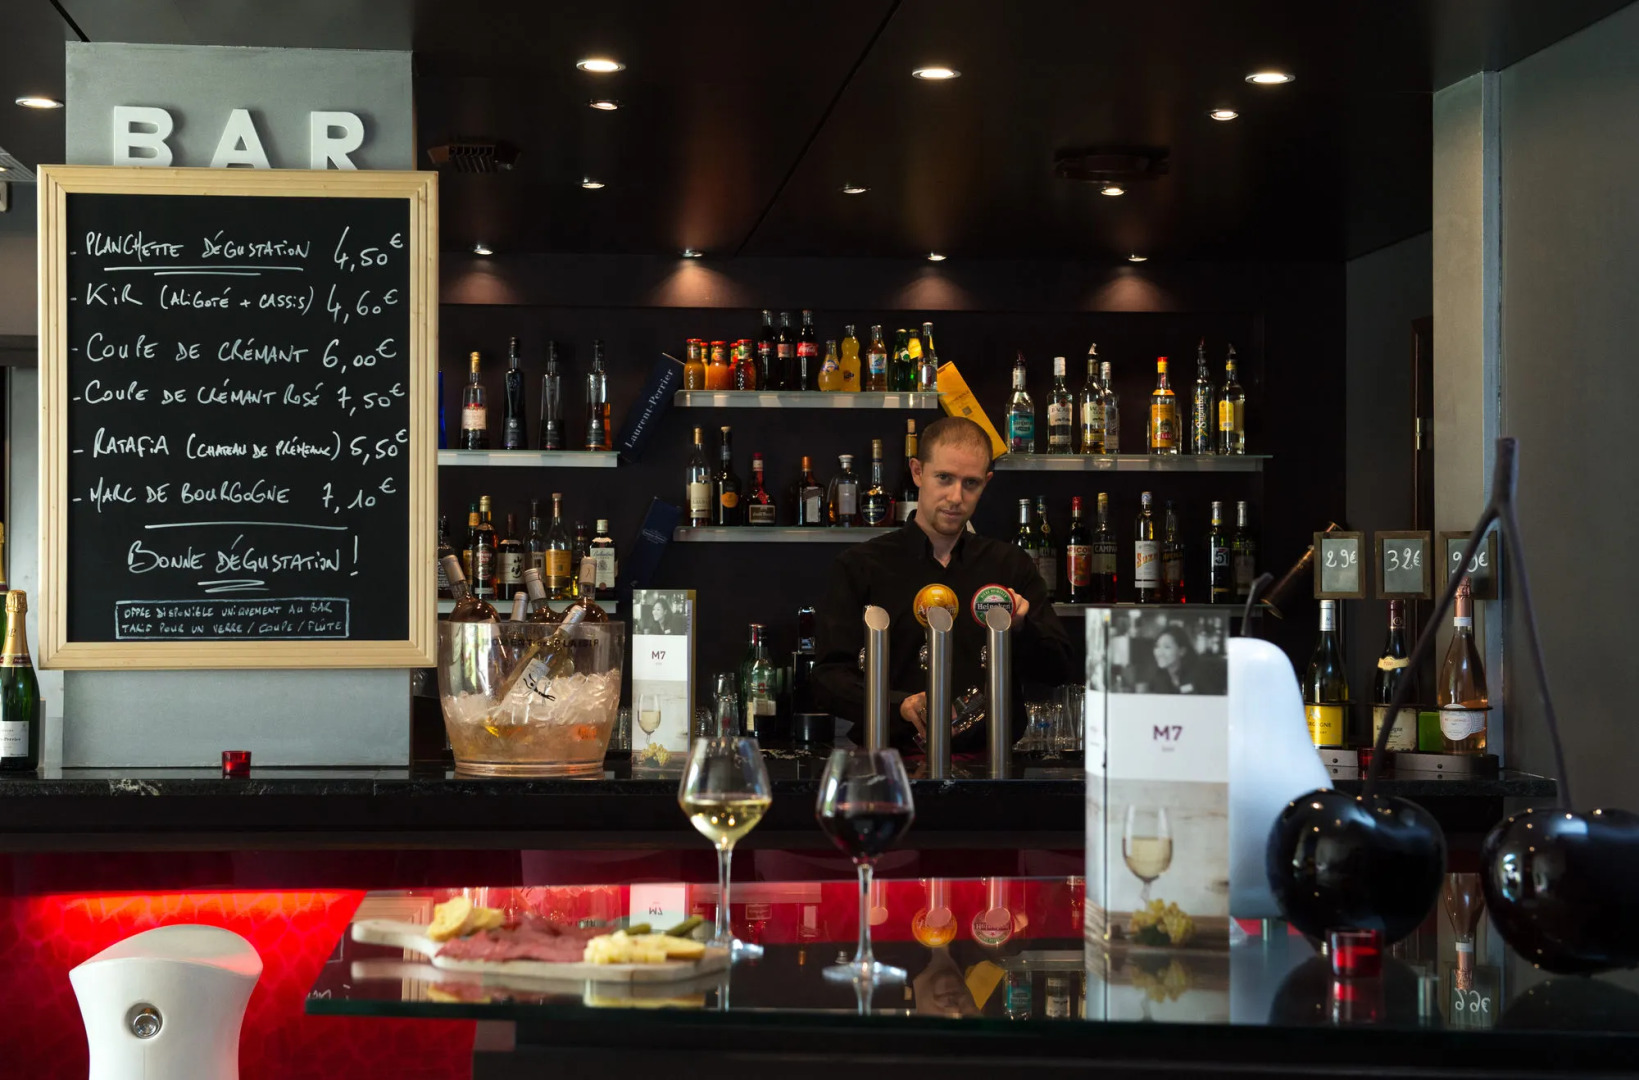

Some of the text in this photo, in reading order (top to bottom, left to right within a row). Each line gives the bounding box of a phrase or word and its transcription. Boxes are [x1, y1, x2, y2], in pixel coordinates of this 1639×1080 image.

[113, 105, 366, 171] BAR
[86, 231, 183, 262] PLANCHETTE
[87, 333, 158, 362] COUPE
[176, 342, 200, 361] DE
[218, 338, 308, 364] CRÉMANT
[85, 380, 148, 404] COUPE
[162, 389, 186, 404] DE
[197, 379, 276, 405] CRÉMANT
[624, 368, 675, 449] Laurent-Perrier
[253, 444, 268, 458] DE
[90, 477, 136, 513] MARC
[146, 483, 170, 503] DE
[181, 479, 290, 503] BOURGOGNE
[128, 540, 205, 573] BONNE
[289, 604, 303, 614] AU
[310, 602, 333, 613] BAR
[160, 622, 184, 633] POUR
[191, 624, 204, 634] UN
[213, 622, 242, 633] VERRE
[259, 620, 293, 633] COUPE
[651, 650, 666, 660] M7
[1152, 725, 1183, 741] M7
